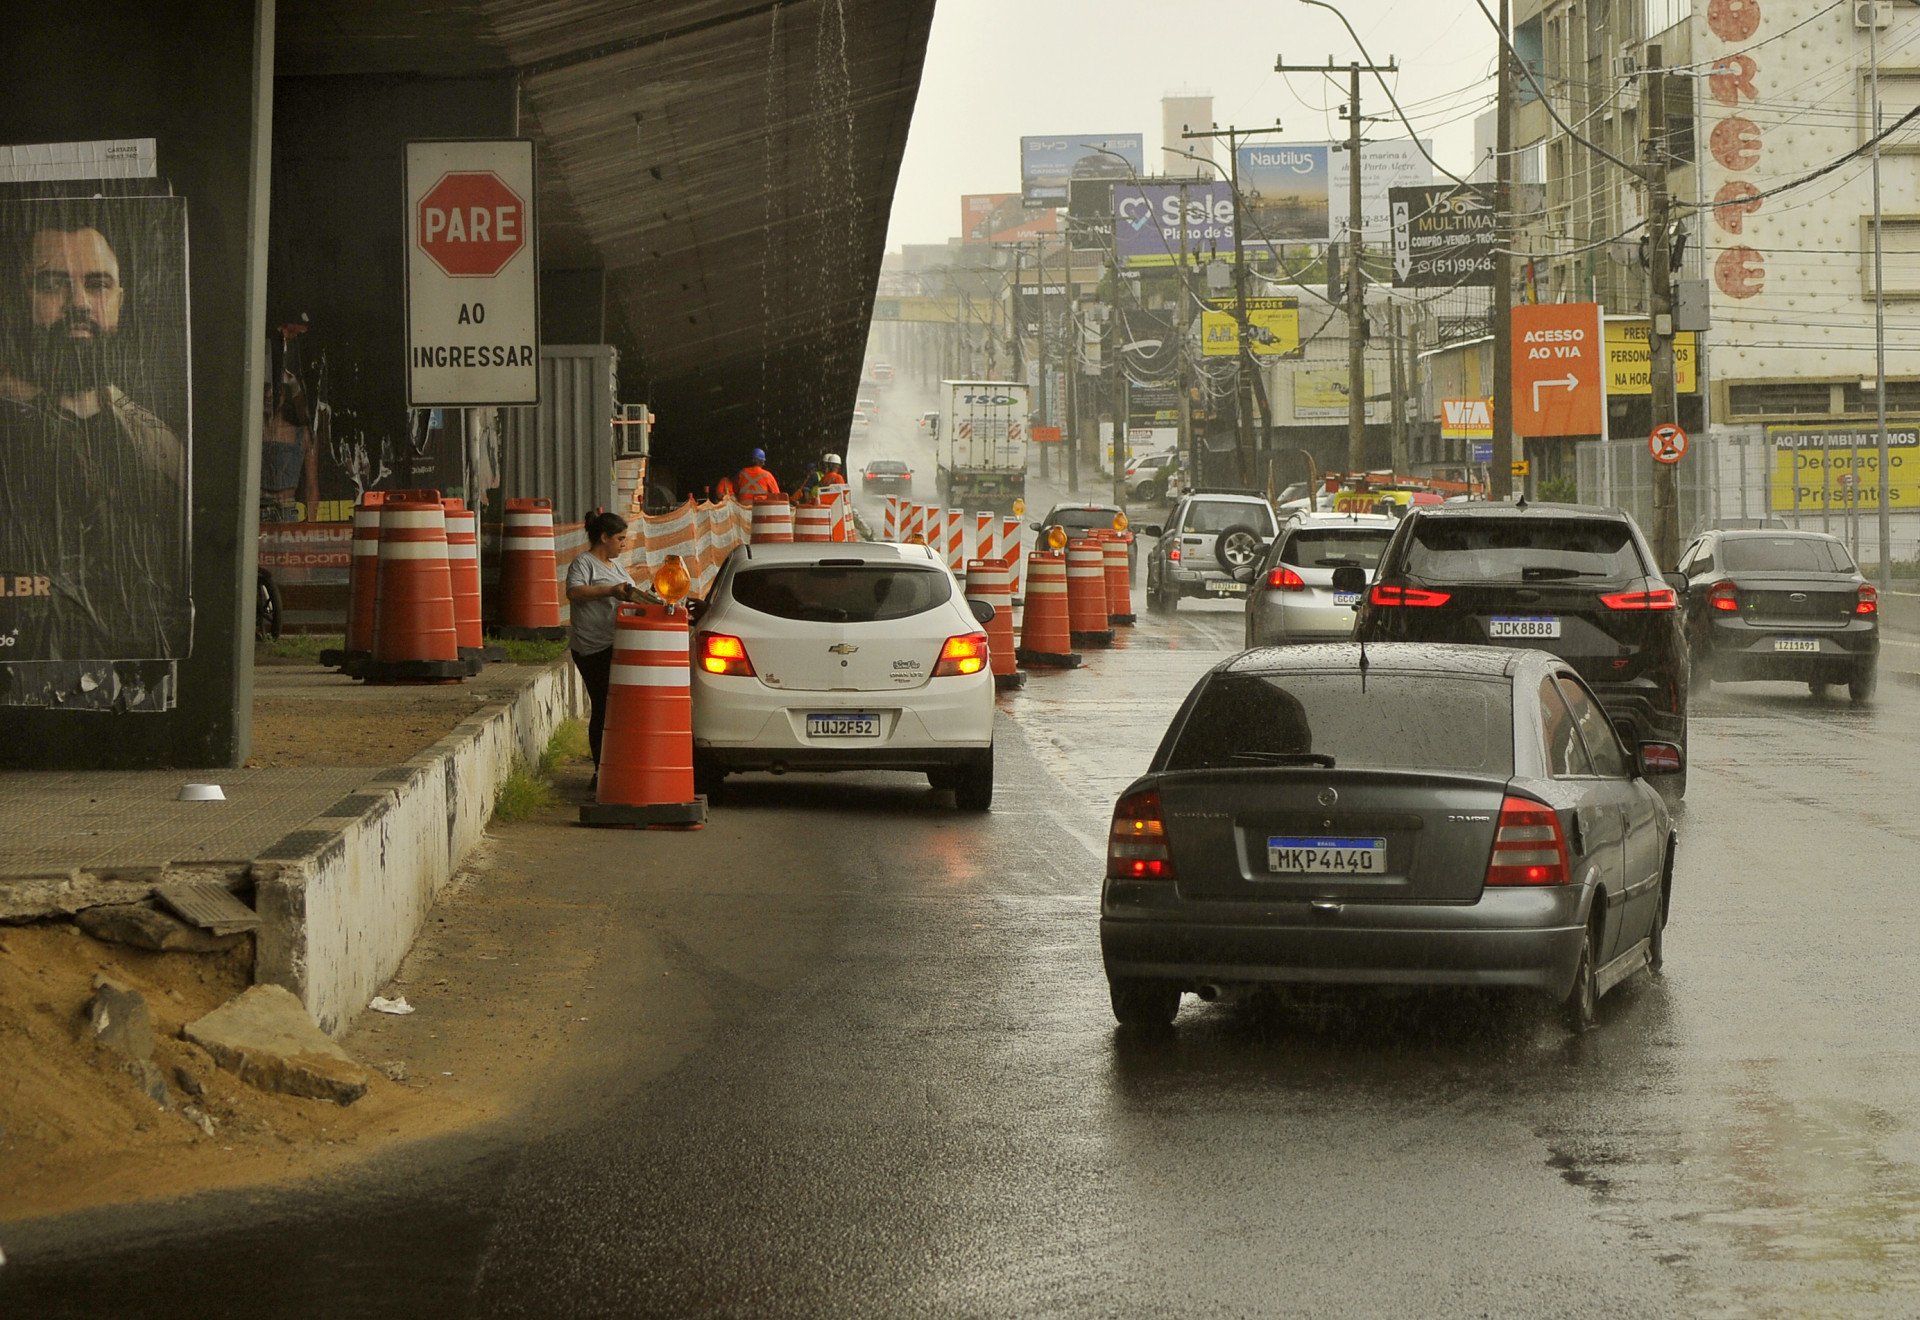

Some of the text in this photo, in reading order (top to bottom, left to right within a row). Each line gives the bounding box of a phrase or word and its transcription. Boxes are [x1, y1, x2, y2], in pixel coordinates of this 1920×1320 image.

[1250, 152, 1314, 174] Nautilus
[1162, 194, 1235, 225] Sole
[425, 205, 517, 243] PARE
[1419, 215, 1496, 231] MULTIMA
[1164, 228, 1201, 239] Plano
[1204, 226, 1221, 238] de
[1411, 235, 1443, 248] COMPRO
[457, 303, 485, 325] AO
[1524, 329, 1585, 343] ACESSO
[413, 345, 533, 368] INGRESSAR
[1528, 345, 1582, 360] AO VIA
[1615, 373, 1628, 385] NA
[964, 395, 1010, 405] TSG
[1872, 432, 1917, 445] TMOS
[1797, 454, 1903, 472] Deoraço
[1799, 486, 1901, 503] Prsents
[1495, 622, 1553, 635] JCK8B88
[813, 721, 873, 734] IUJ2F52
[1277, 849, 1373, 870] MKP4A40
